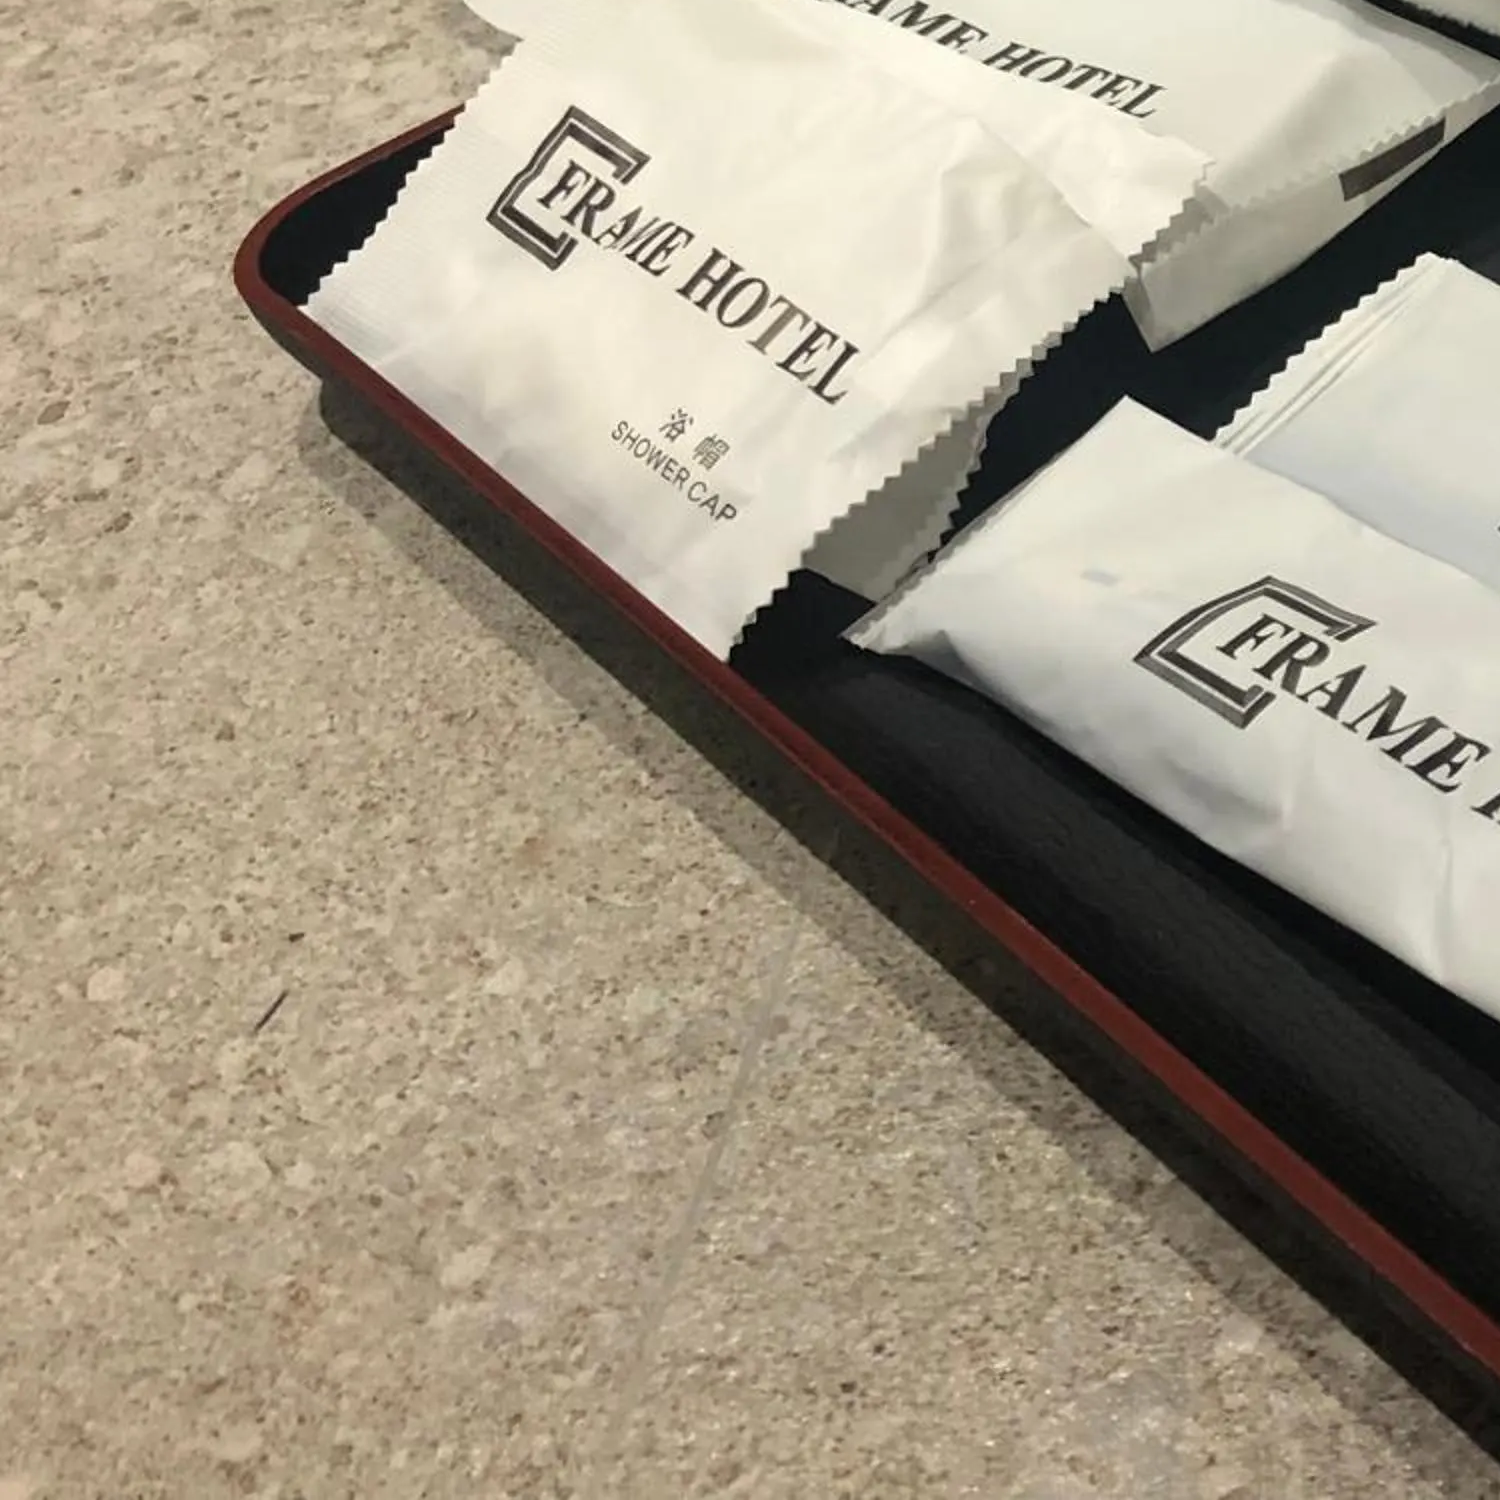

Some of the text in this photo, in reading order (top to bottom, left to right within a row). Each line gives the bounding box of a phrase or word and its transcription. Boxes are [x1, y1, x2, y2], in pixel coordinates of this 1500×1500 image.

[982, 41, 1168, 118] HOTEL
[675, 247, 860, 405] HOTEL
[611, 420, 737, 521] SHOWER CAP
[1216, 613, 1492, 793] FRAME
